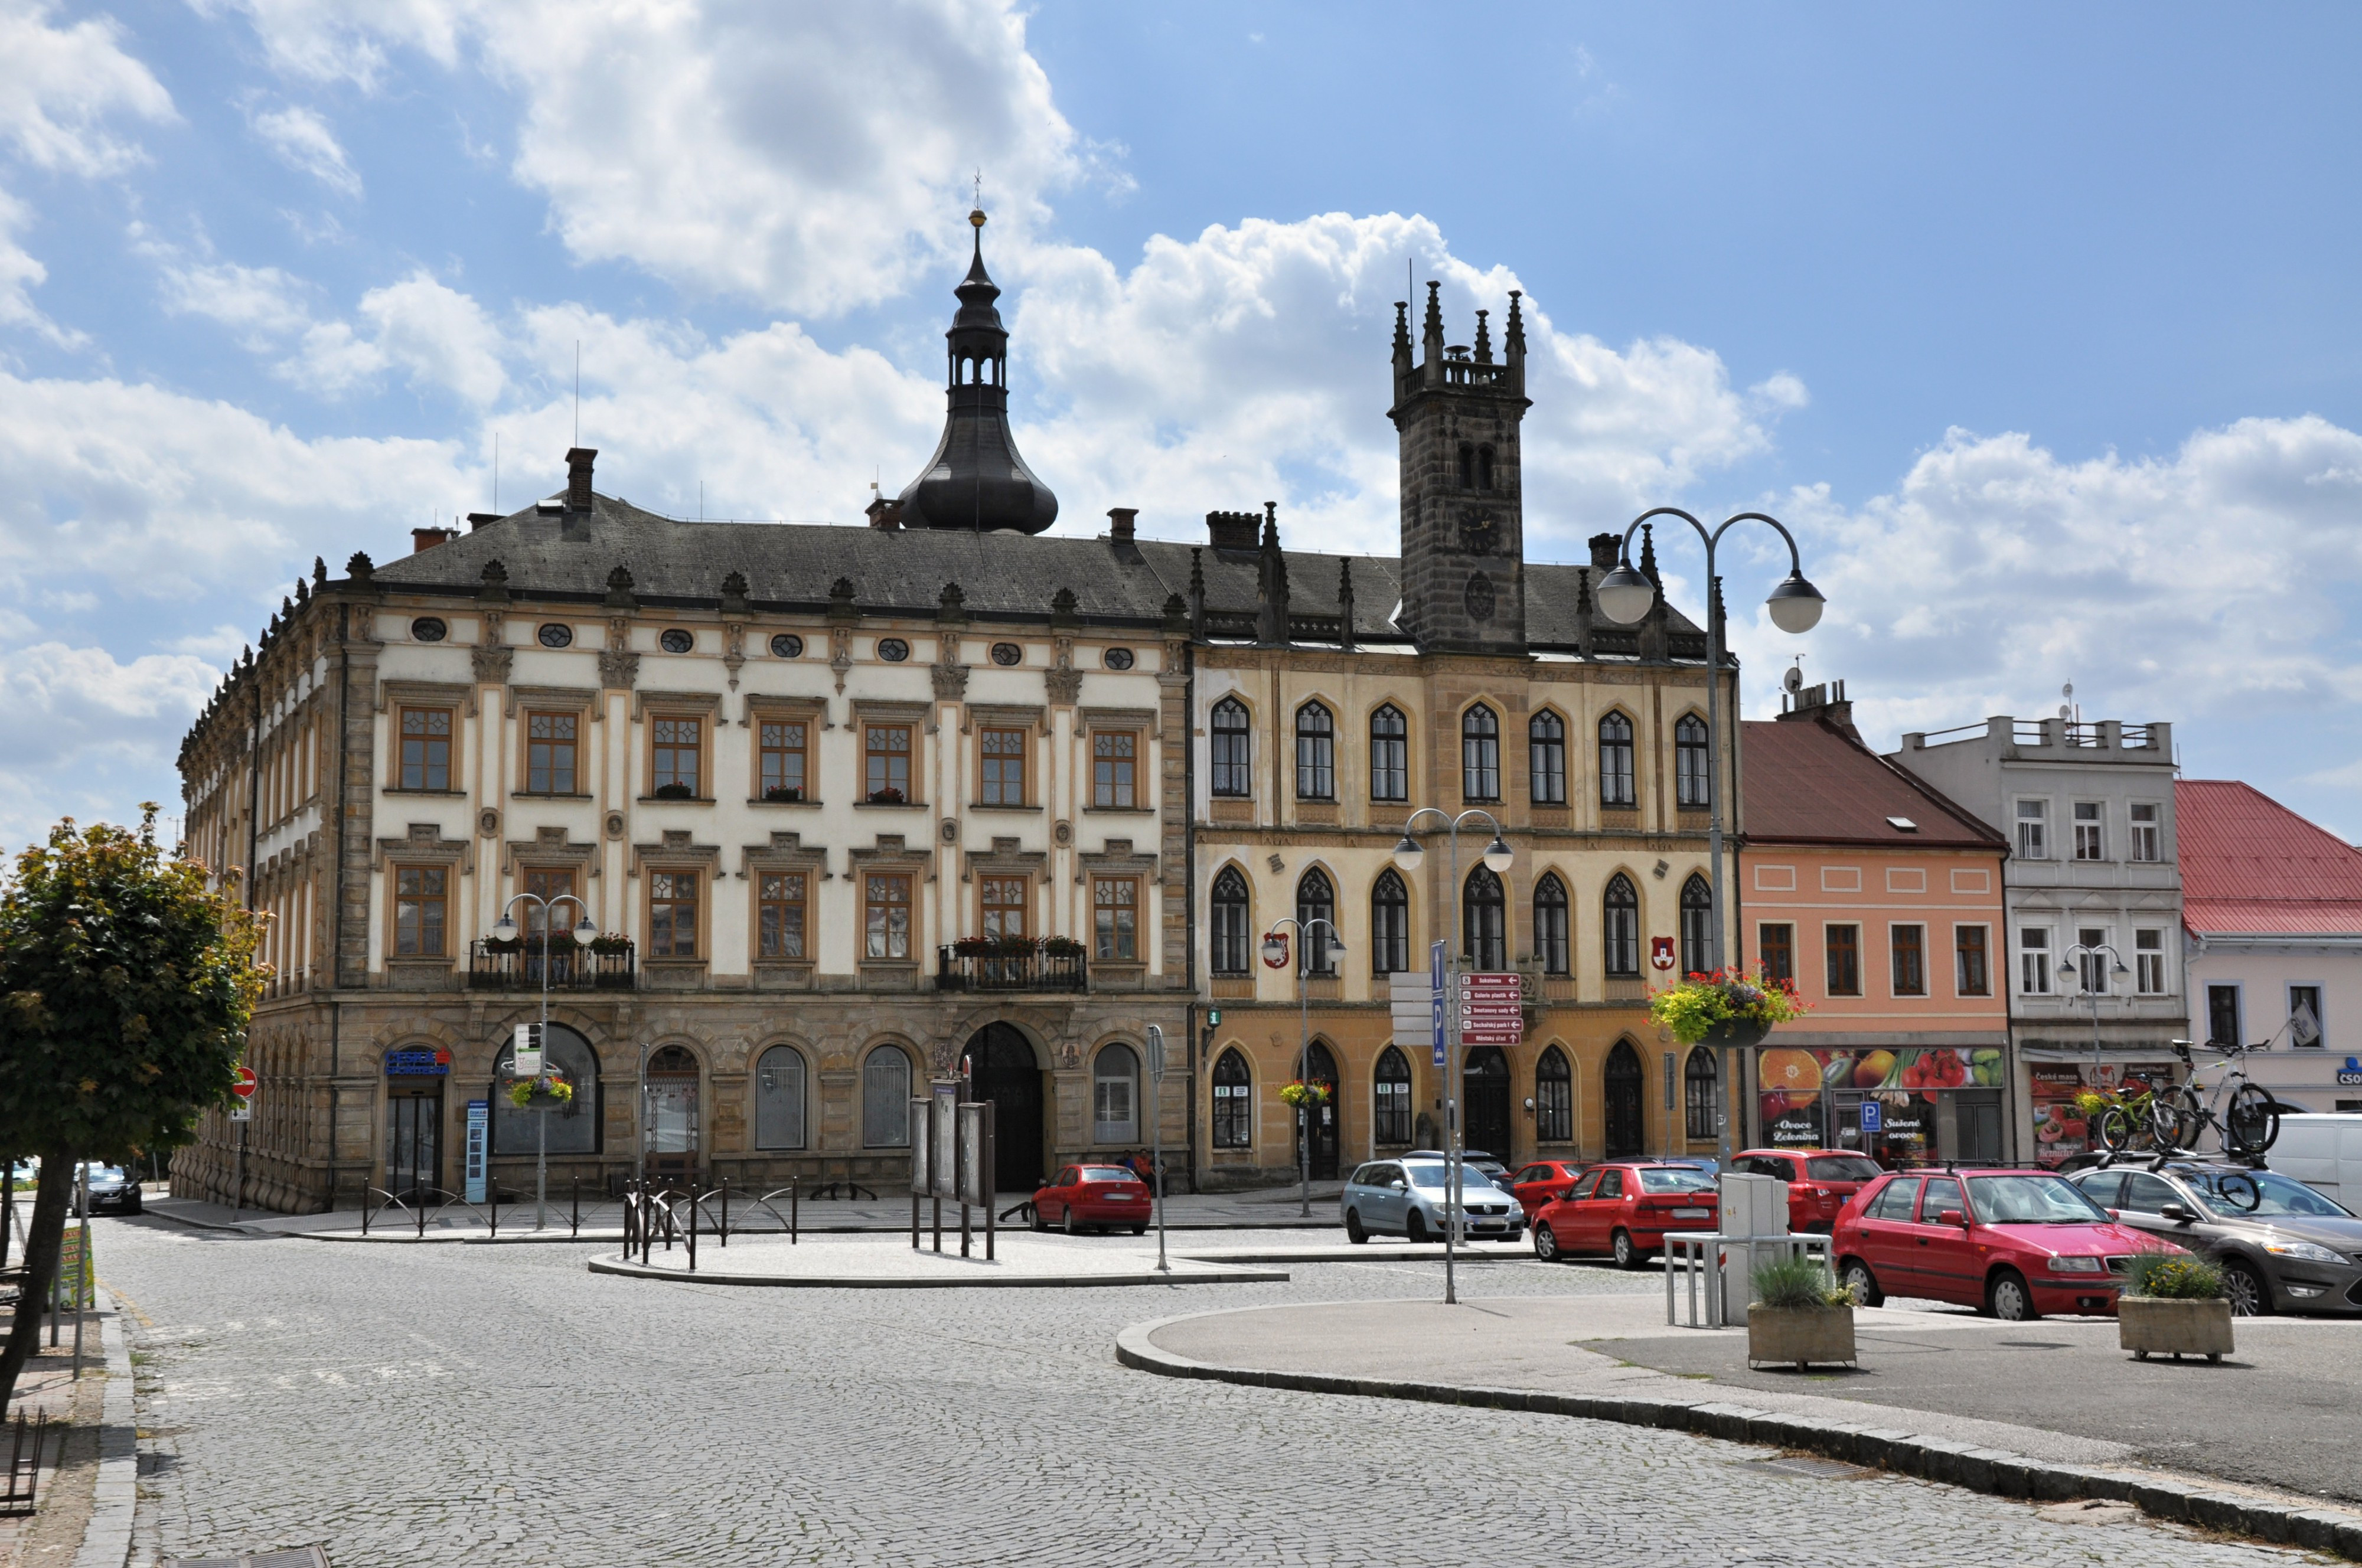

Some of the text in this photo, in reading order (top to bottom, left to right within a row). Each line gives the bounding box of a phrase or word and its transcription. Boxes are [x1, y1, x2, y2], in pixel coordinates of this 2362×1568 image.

[1435, 1005, 1441, 1044] P
[386, 1049, 436, 1063] ČESKÁ
[386, 1064, 450, 1075] SPOŘITELNA
[2035, 1072, 2057, 1080] České
[2340, 1074, 2362, 1084] ČSO
[1865, 1106, 1876, 1123] P
[1780, 1120, 1812, 1129] Ovoce
[1885, 1118, 1921, 1128] Sušené
[1773, 1131, 1819, 1141] Zelenina
